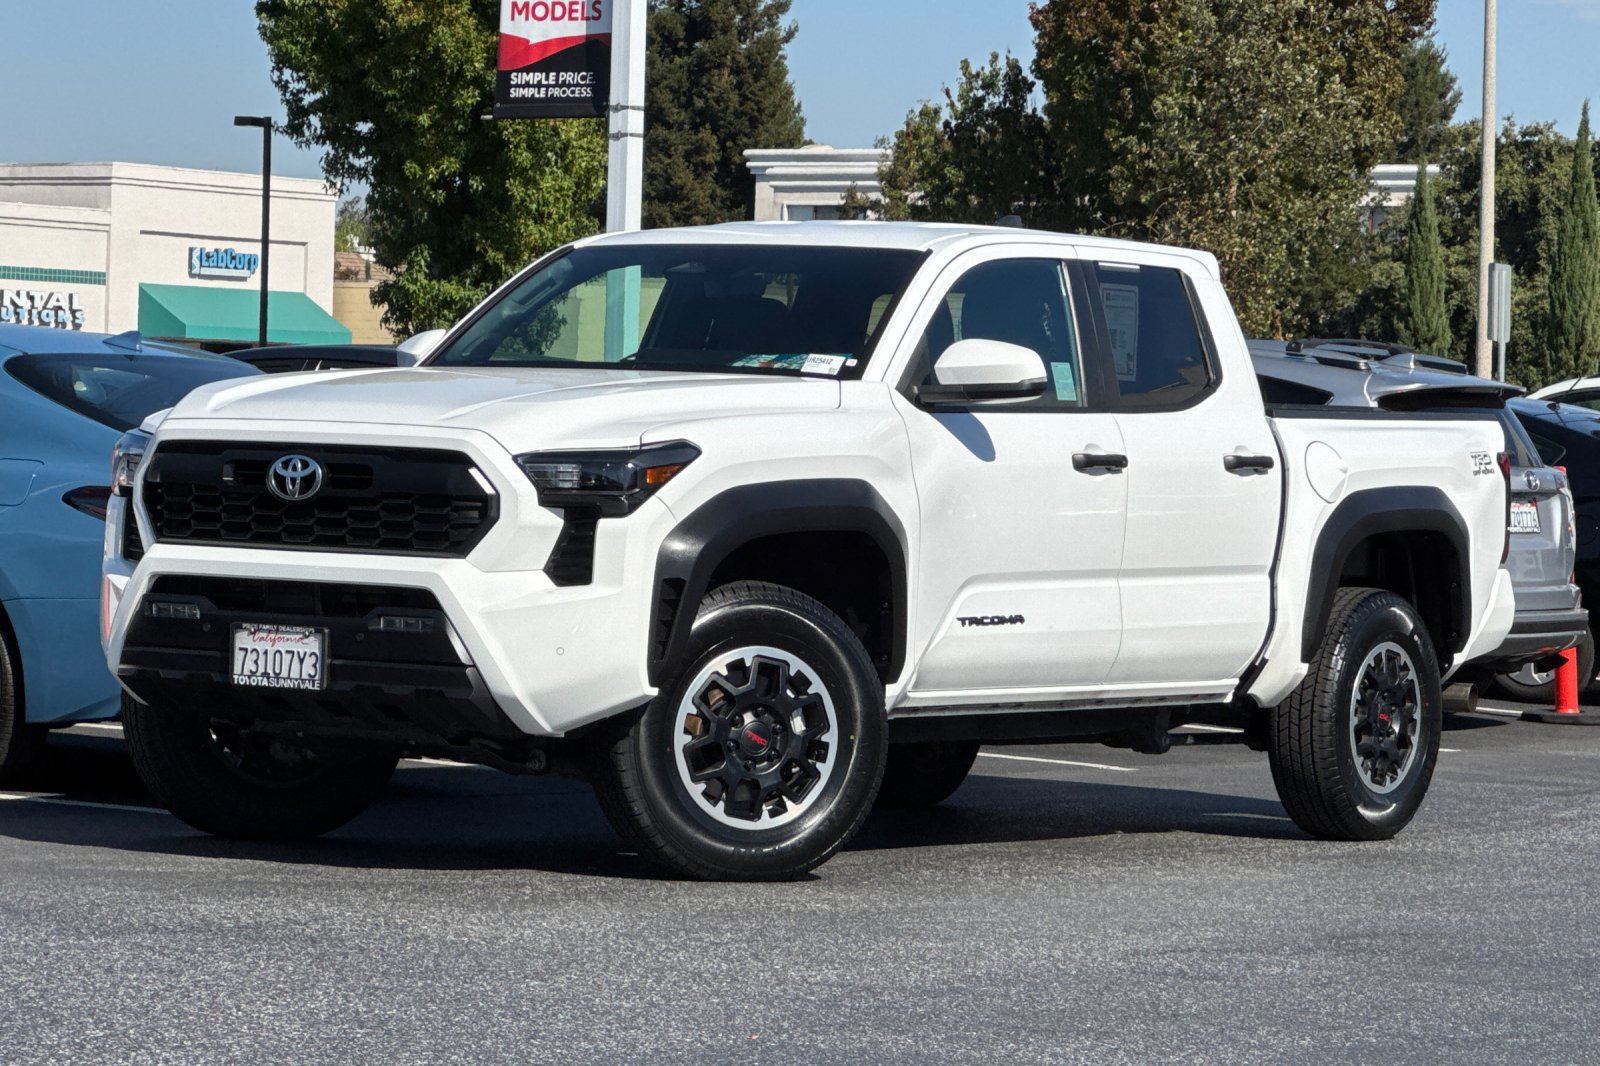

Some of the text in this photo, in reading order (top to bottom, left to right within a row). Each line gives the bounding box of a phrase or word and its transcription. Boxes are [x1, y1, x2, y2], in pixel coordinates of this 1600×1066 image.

[510, 0, 602, 22] MODELS
[510, 71, 596, 85] SIMPLE PRICE.
[509, 86, 594, 98] SIMPLE PROCESS.
[201, 247, 259, 274] LabCorp
[956, 614, 1025, 627] TACOMA
[239, 646, 319, 679] 73107Y3
[233, 675, 320, 690] TOYOTA SUNNYVALE
